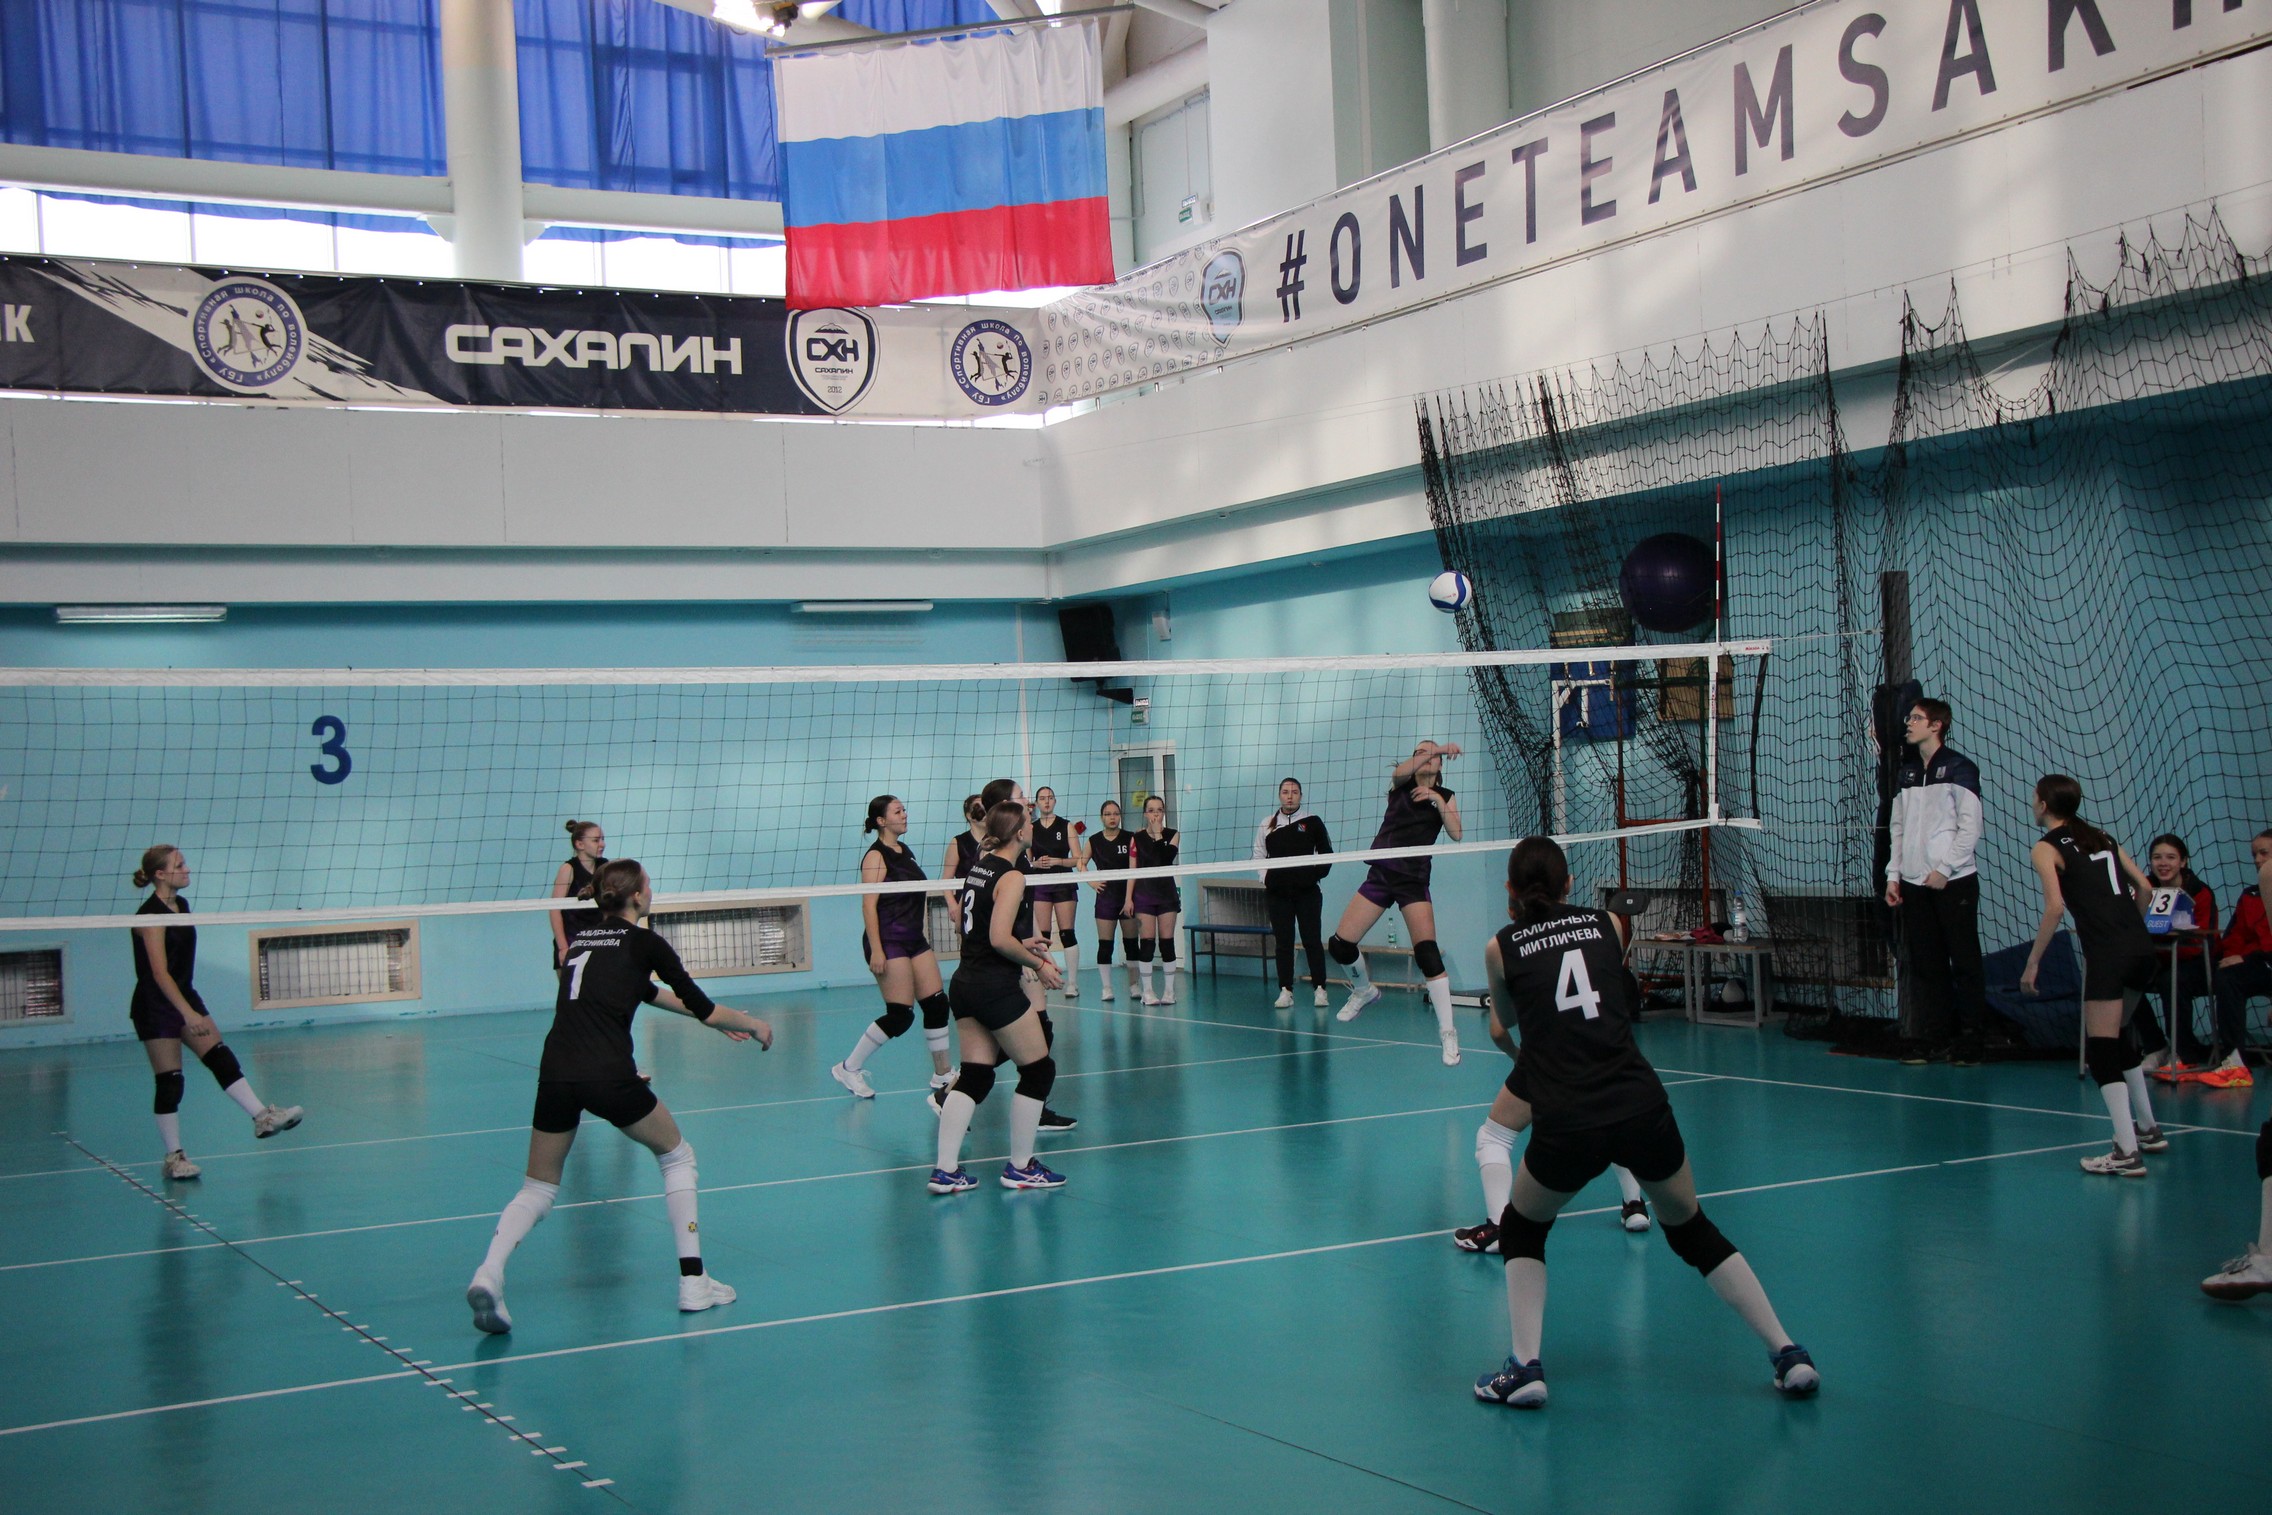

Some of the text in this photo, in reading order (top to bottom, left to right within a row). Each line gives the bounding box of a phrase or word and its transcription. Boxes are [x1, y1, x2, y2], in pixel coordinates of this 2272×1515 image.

[1276, 0, 2243, 323] #ONETEAMSAK
[0, 303, 36, 343] К
[219, 367, 244, 383] ГБУ
[234, 287, 275, 302] школа
[276, 303, 290, 318] по
[980, 322, 1010, 335] школа
[445, 323, 743, 375] САХАЛИН
[806, 337, 860, 363] СХН
[1013, 334, 1023, 346] по
[814, 367, 854, 375] САХАЛИН
[827, 385, 843, 394] 2012
[971, 392, 990, 404] ГБУ
[310, 715, 352, 785] 3
[1056, 831, 1062, 841] 8
[1117, 845, 1128, 854] 16
[2089, 851, 2122, 895] 7
[963, 889, 976, 935] 3
[2155, 894, 2171, 913] 3
[1511, 914, 1599, 942] СМИРНЫХ
[2147, 920, 2169, 928] GUEST
[1519, 928, 1603, 958] МИТЛИЧЕВА
[567, 950, 593, 1000] 1
[1555, 948, 1601, 1021] 4
